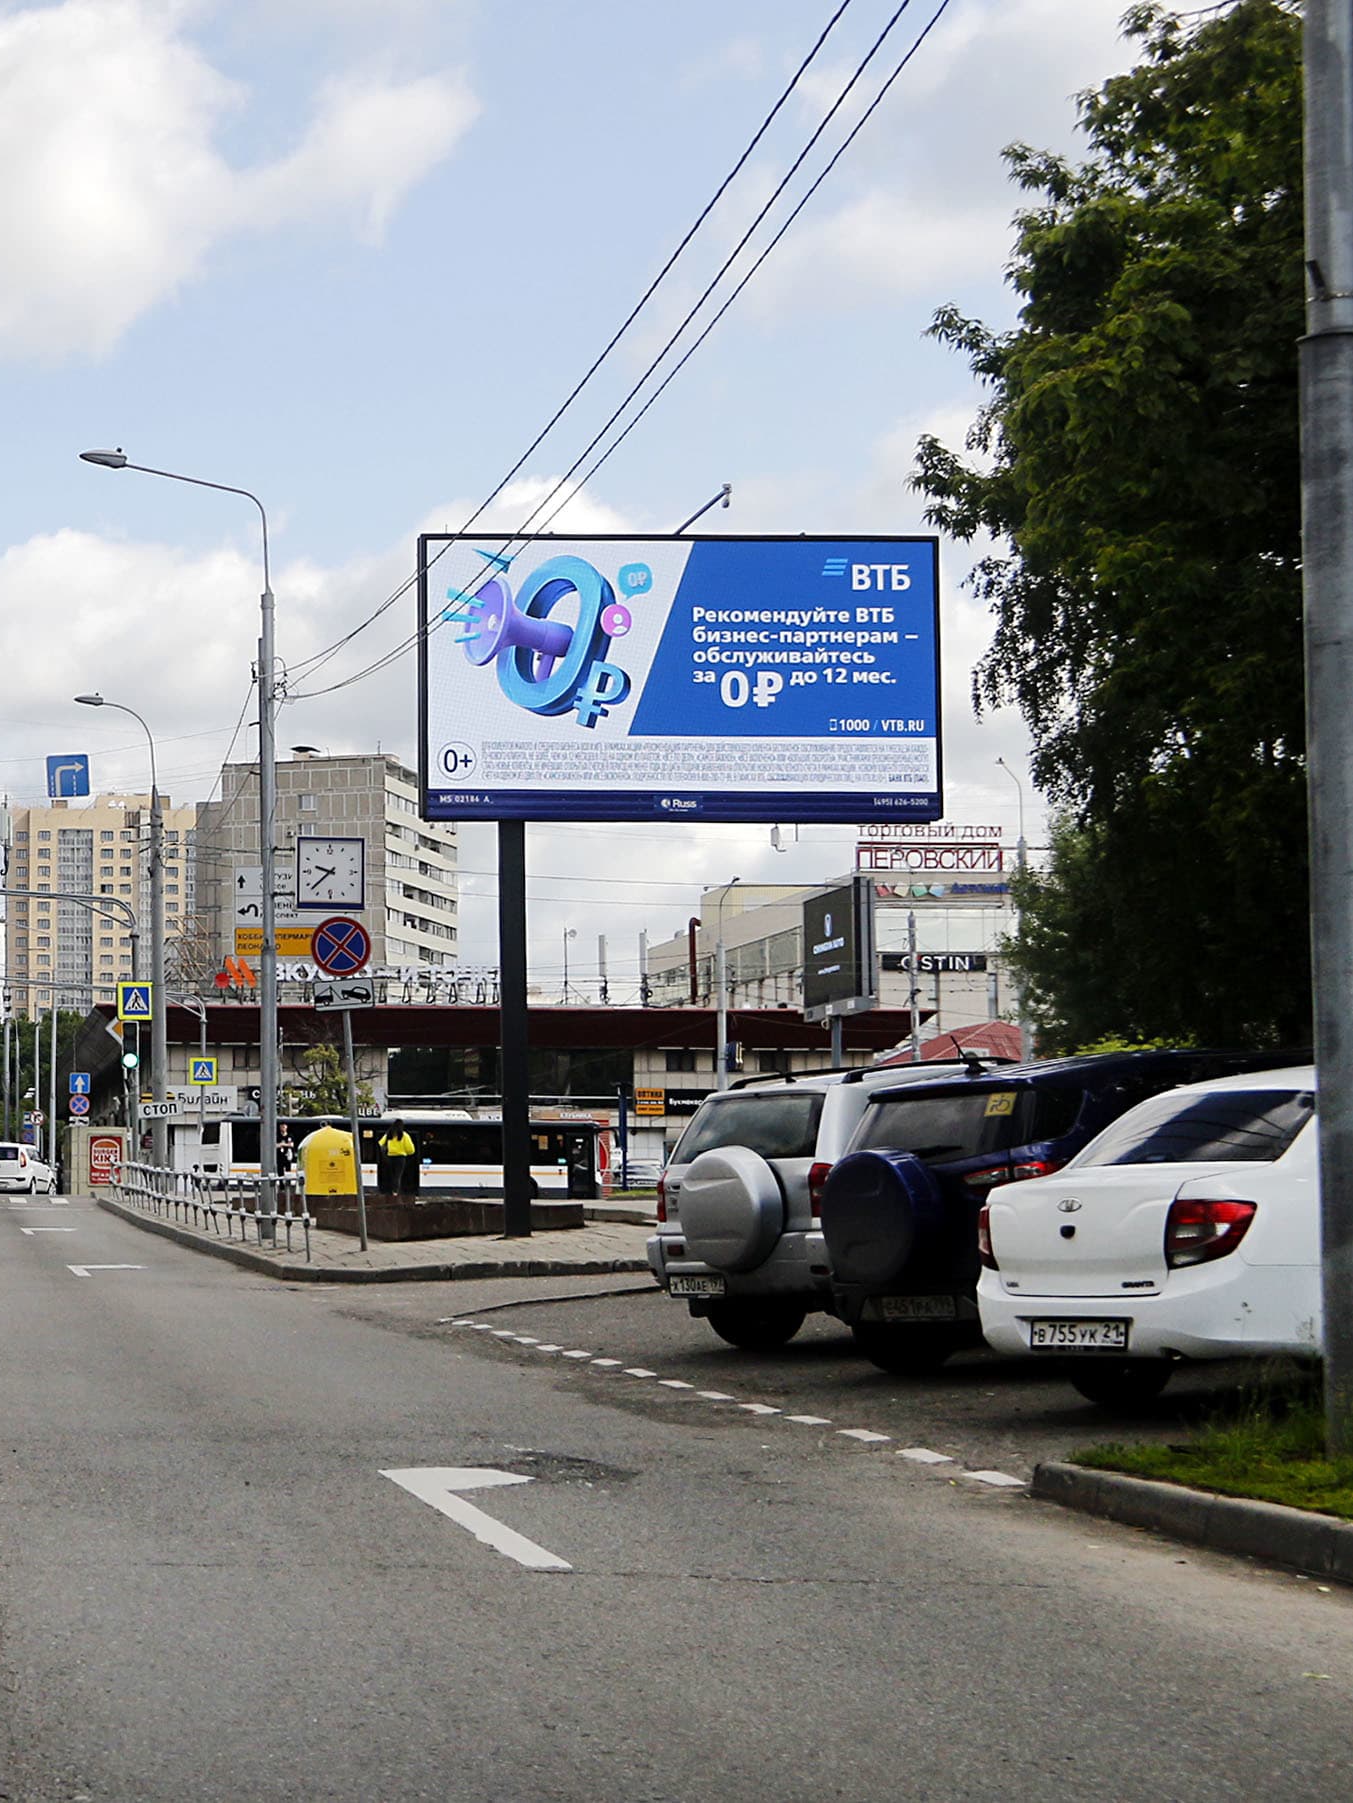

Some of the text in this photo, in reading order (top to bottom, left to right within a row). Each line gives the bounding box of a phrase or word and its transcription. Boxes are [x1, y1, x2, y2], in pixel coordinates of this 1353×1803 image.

[851, 564, 911, 591] ВТБ
[692, 606, 895, 627] Рекомендуйте ВТБ
[692, 626, 898, 647] бизнес-партнерам
[693, 647, 876, 668] обслуживайтесь
[692, 670, 716, 683] за
[790, 669, 818, 686] до
[822, 667, 848, 684] 12
[852, 670, 897, 684] мес.
[839, 719, 870, 732] 1000
[881, 719, 925, 732] VTB.RU
[443, 749, 473, 773] 0+
[673, 799, 697, 808] Russ
[857, 845, 1003, 870] ПЕРОВСКИЙ
[143, 1103, 178, 1115] СТОП
[1038, 1324, 1120, 1344] В755УК 21
